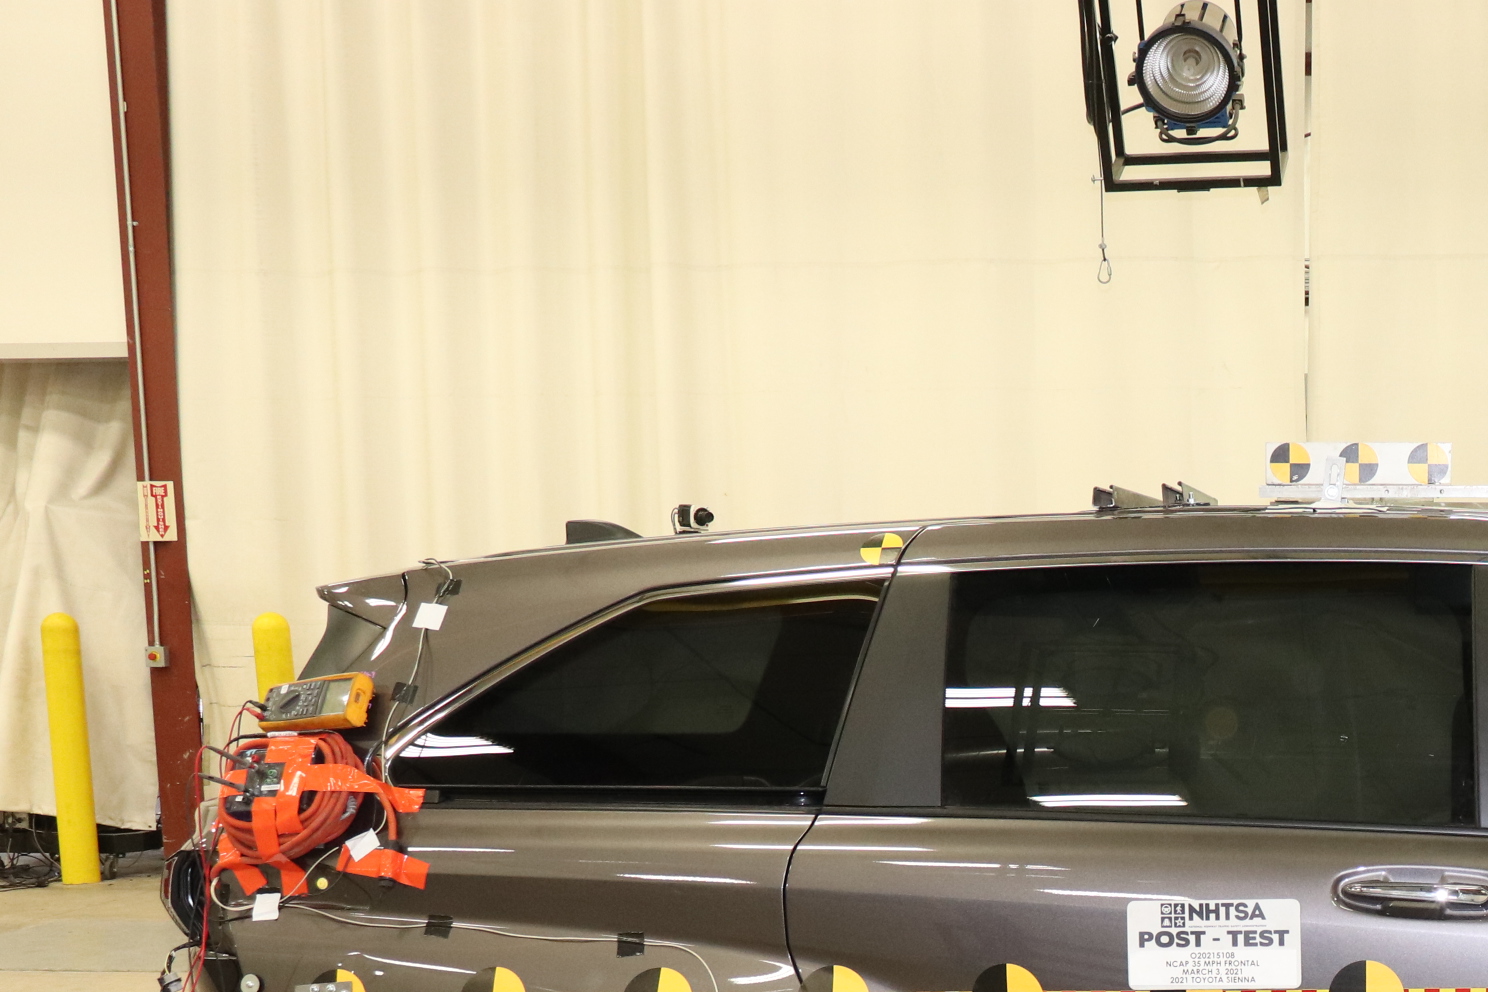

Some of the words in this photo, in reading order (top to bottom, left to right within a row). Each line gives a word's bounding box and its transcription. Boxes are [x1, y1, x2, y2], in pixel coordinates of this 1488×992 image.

[1188, 902, 1266, 921] NHTSA
[1138, 930, 1206, 948] POST
[1227, 930, 1289, 947] TEST
